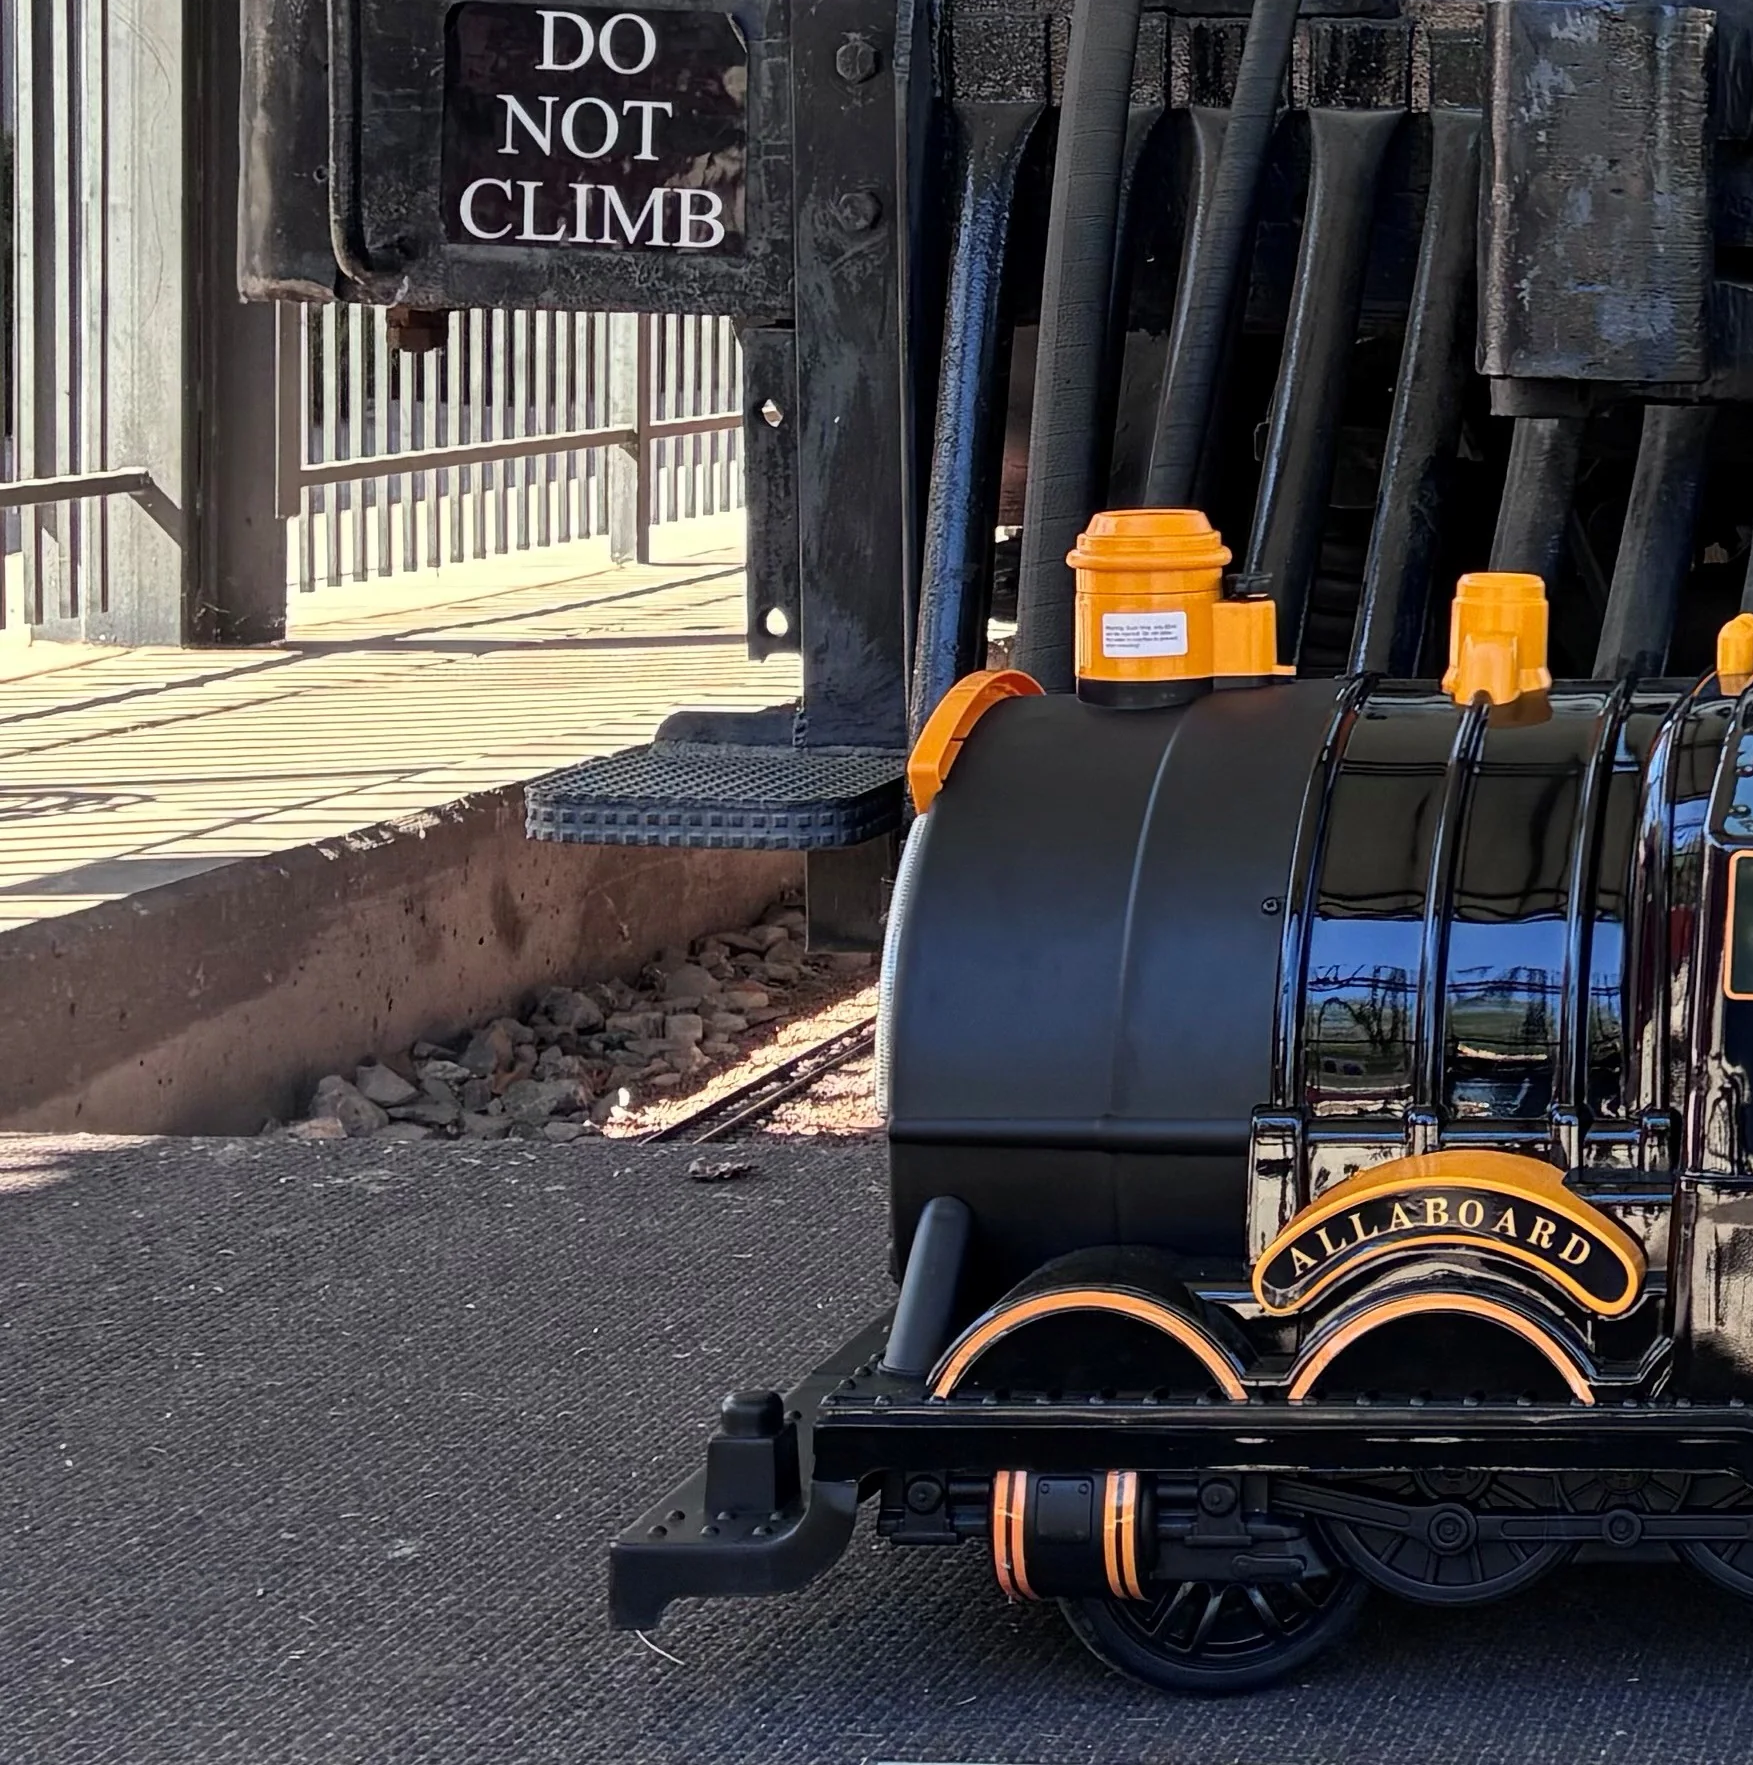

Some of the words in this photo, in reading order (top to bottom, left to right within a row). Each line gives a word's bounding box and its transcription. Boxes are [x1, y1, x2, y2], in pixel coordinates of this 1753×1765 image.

[535, 10, 656, 75] DO
[496, 94, 672, 161] NOT
[459, 177, 725, 248] CLIMB
